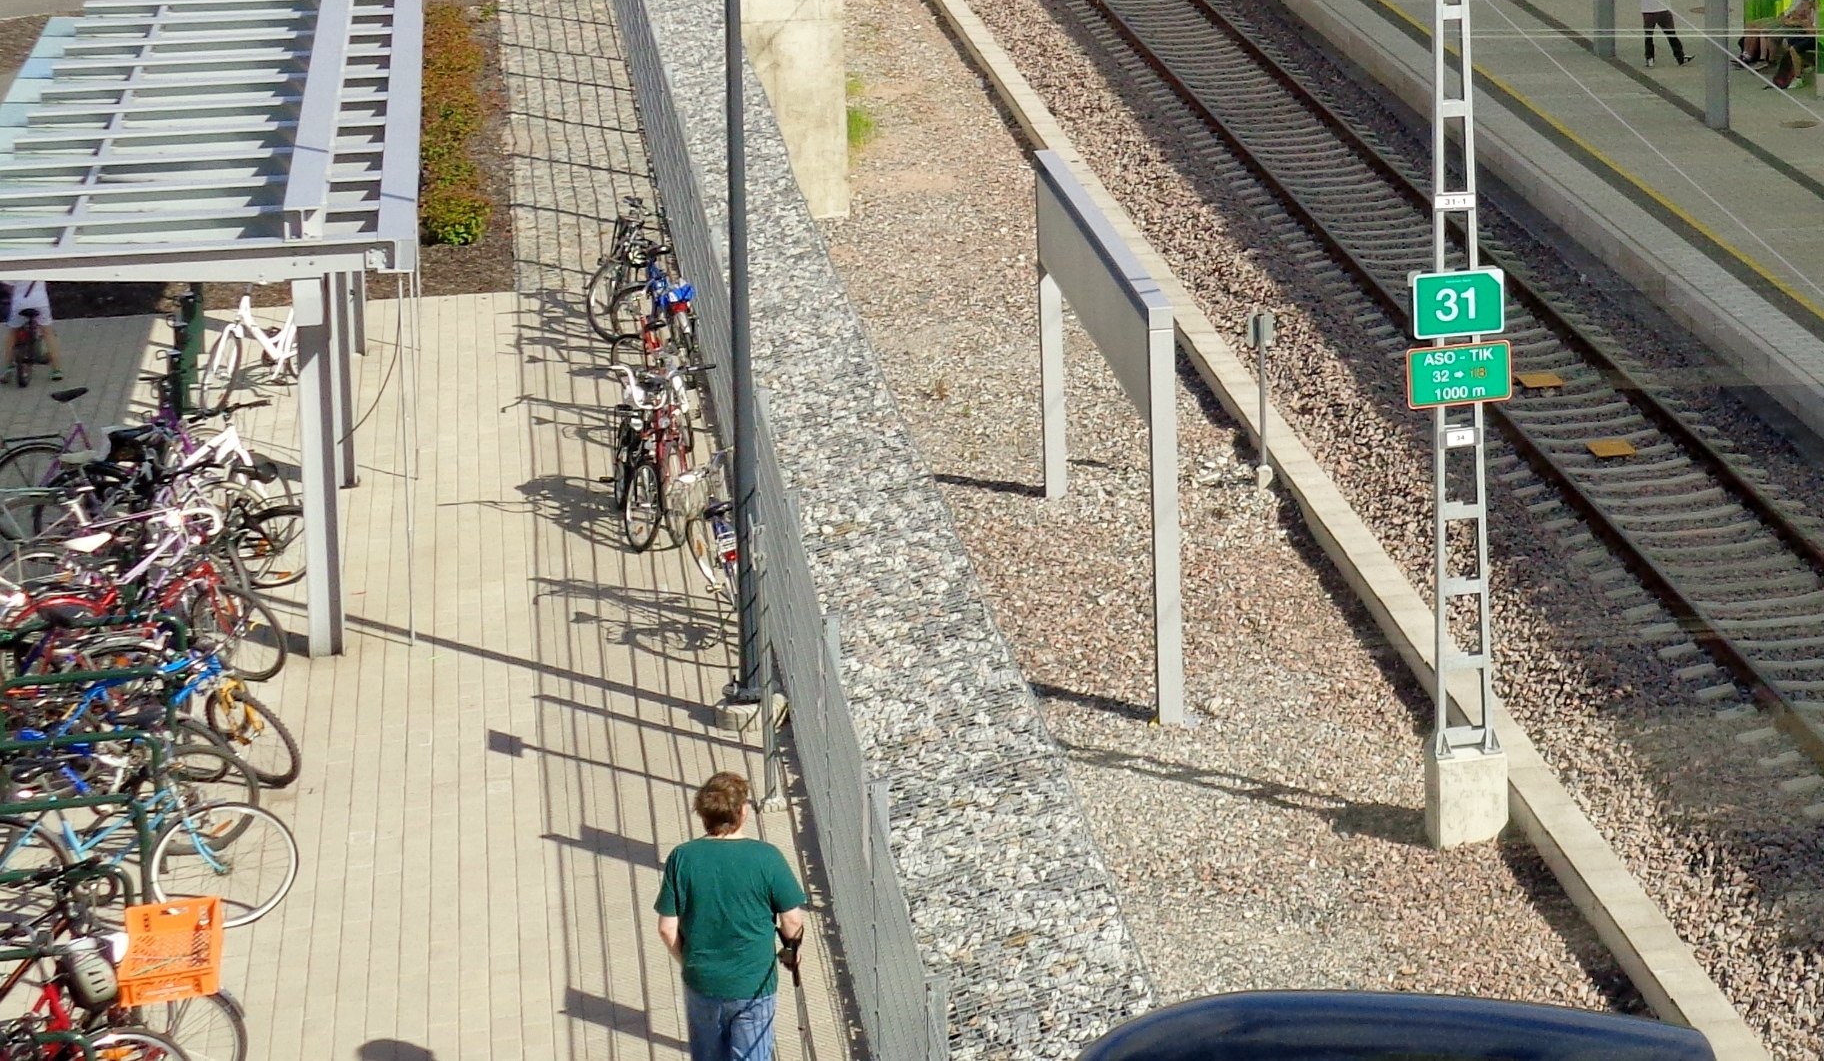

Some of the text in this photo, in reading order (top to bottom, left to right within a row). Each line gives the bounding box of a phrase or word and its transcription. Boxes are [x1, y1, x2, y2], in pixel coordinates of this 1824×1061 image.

[1435, 286, 1476, 322] 31
[1423, 351, 1456, 366] ASO
[1469, 347, 1494, 362] TIK
[1432, 369, 1450, 383] 32
[1434, 385, 1486, 401] 1000 m
